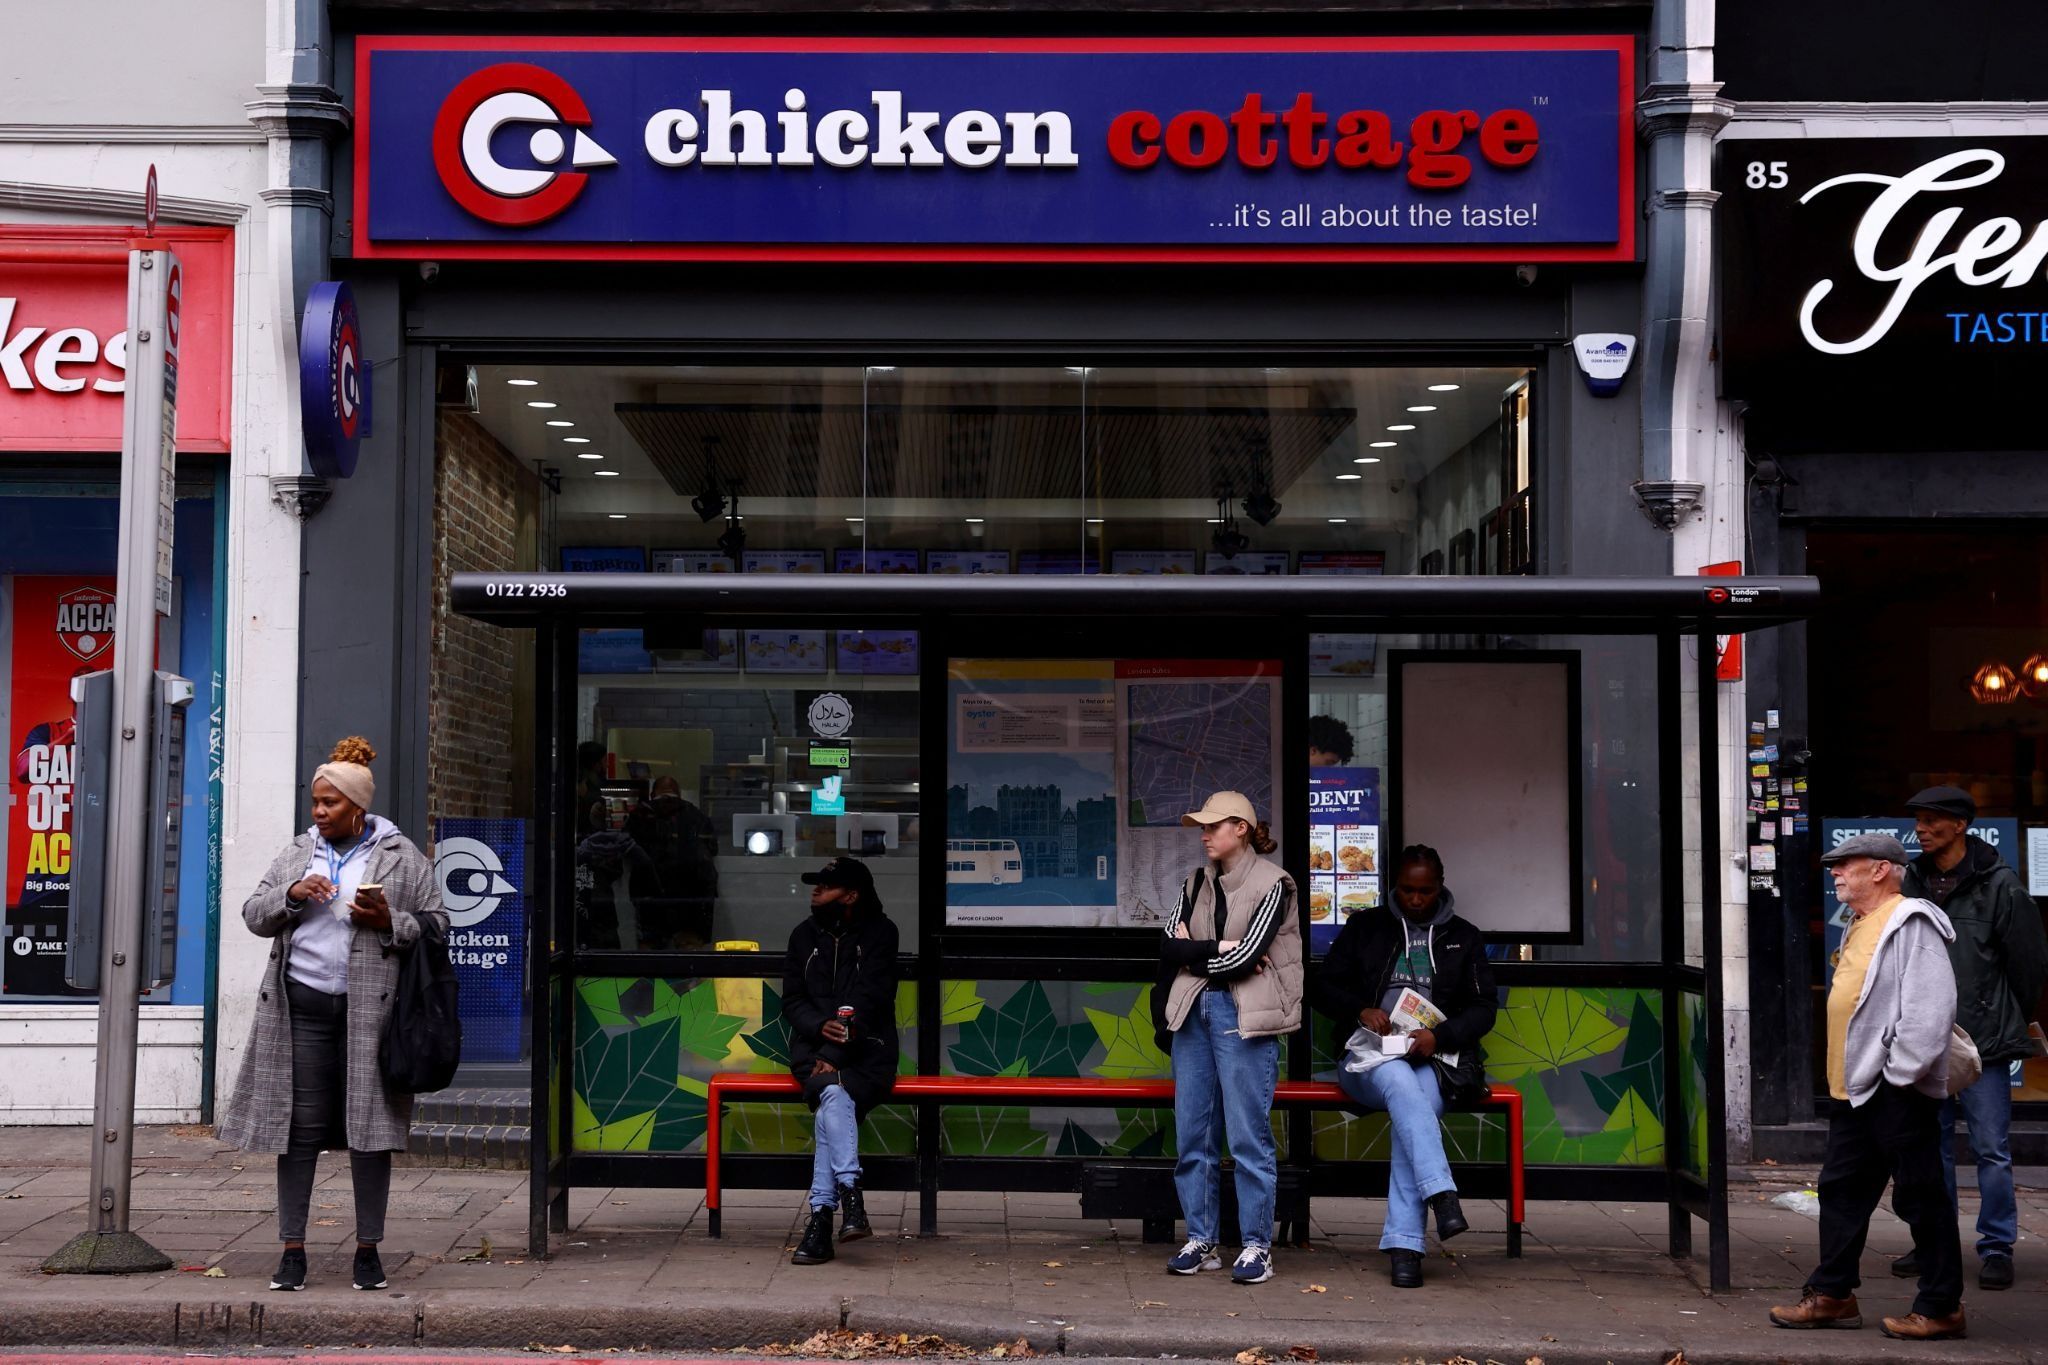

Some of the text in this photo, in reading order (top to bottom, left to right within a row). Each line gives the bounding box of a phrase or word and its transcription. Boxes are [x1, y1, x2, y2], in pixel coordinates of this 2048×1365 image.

[644, 88, 1078, 167] chicken
[1107, 92, 1539, 190] cottage
[1746, 161, 1789, 189] 85
[1280, 203, 1310, 227] all
[1321, 203, 1399, 227] about
[1408, 203, 1452, 227] the
[1461, 203, 1538, 227] taste!
[486, 583, 567, 597] 0122 2936
[1731, 588, 1759, 596] London
[56, 603, 117, 632] ACCA
[816, 703, 845, 720] حلال
[967, 710, 996, 719] oyster
[28, 744, 76, 784] GA
[1309, 790, 1364, 806] DENT
[27, 784, 71, 831] OF
[25, 881, 43, 892] Big
[35, 942, 62, 950] TAKE
[448, 930, 510, 946] icken
